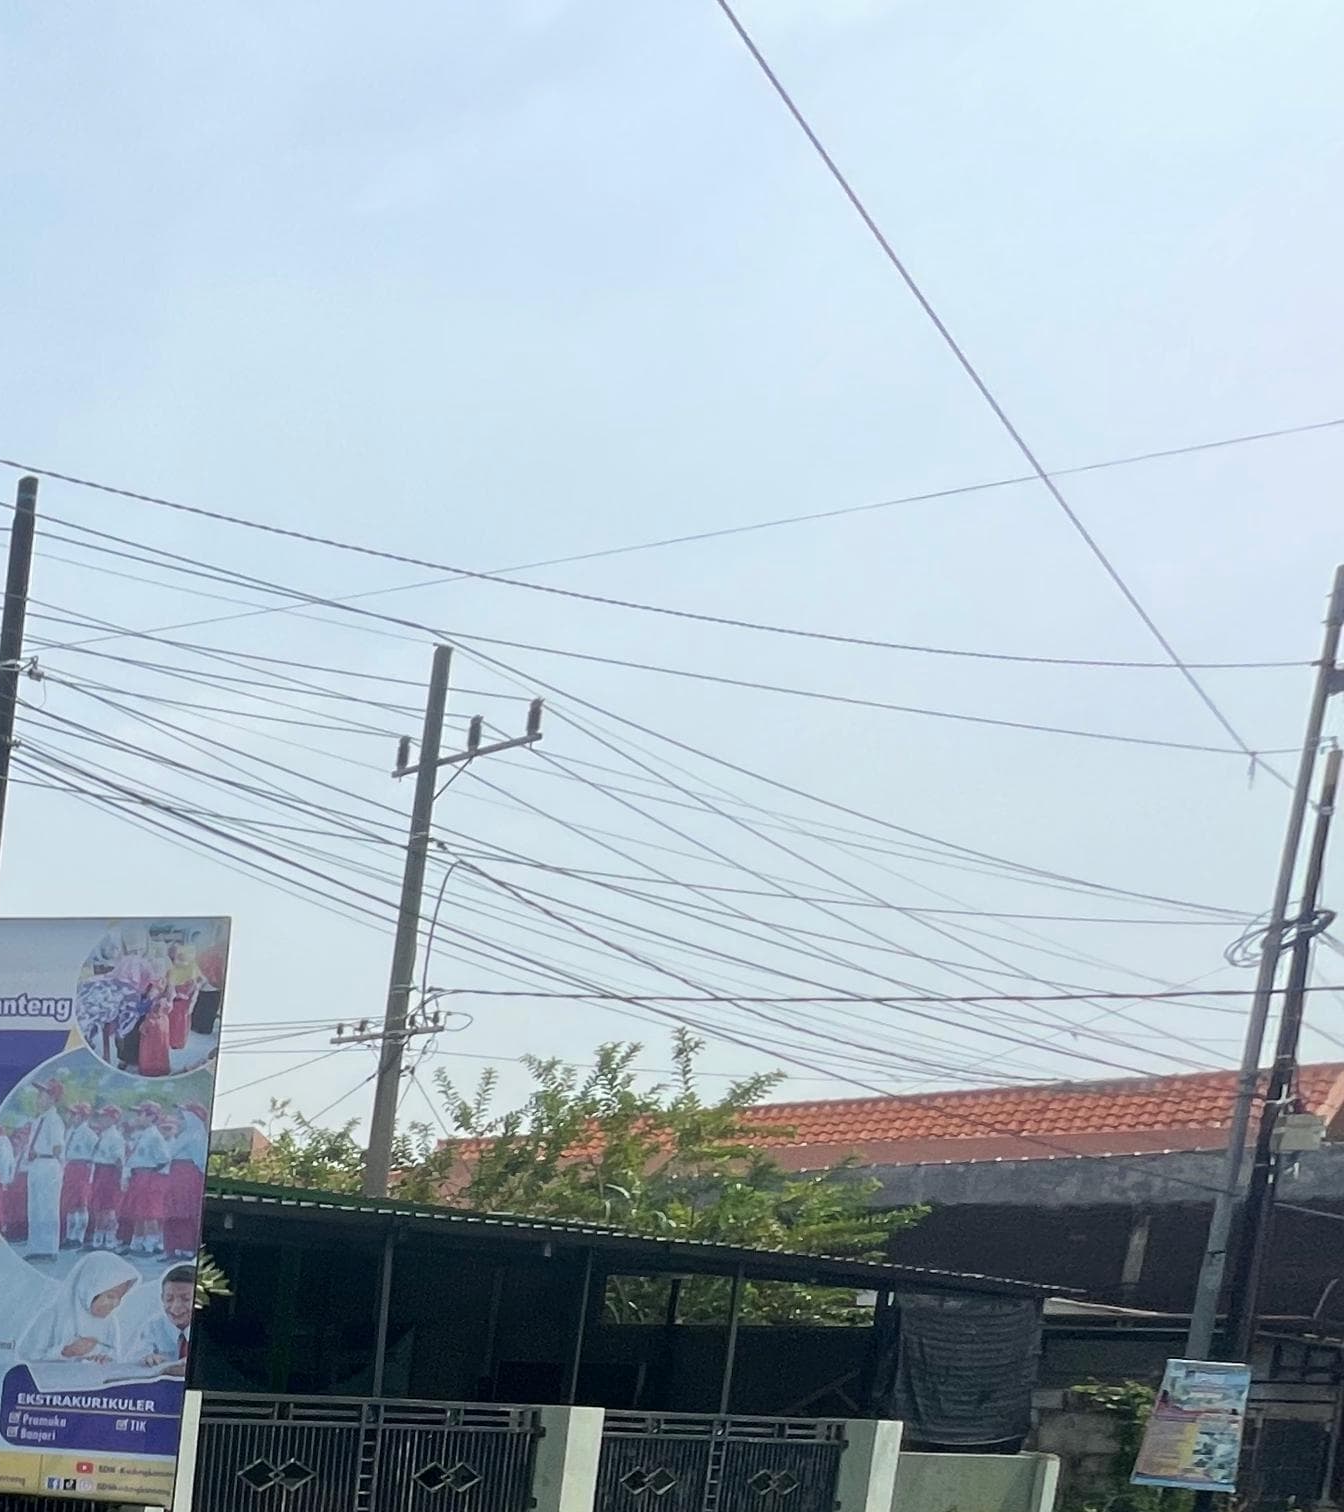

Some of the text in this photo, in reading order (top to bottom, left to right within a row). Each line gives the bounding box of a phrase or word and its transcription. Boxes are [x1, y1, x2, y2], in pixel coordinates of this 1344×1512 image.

[17, 1392, 156, 1412] EKSTRAKURIKULER
[22, 1412, 66, 1428] Pramuka
[130, 1420, 147, 1432] TIK
[20, 1426, 56, 1442] Banjari
